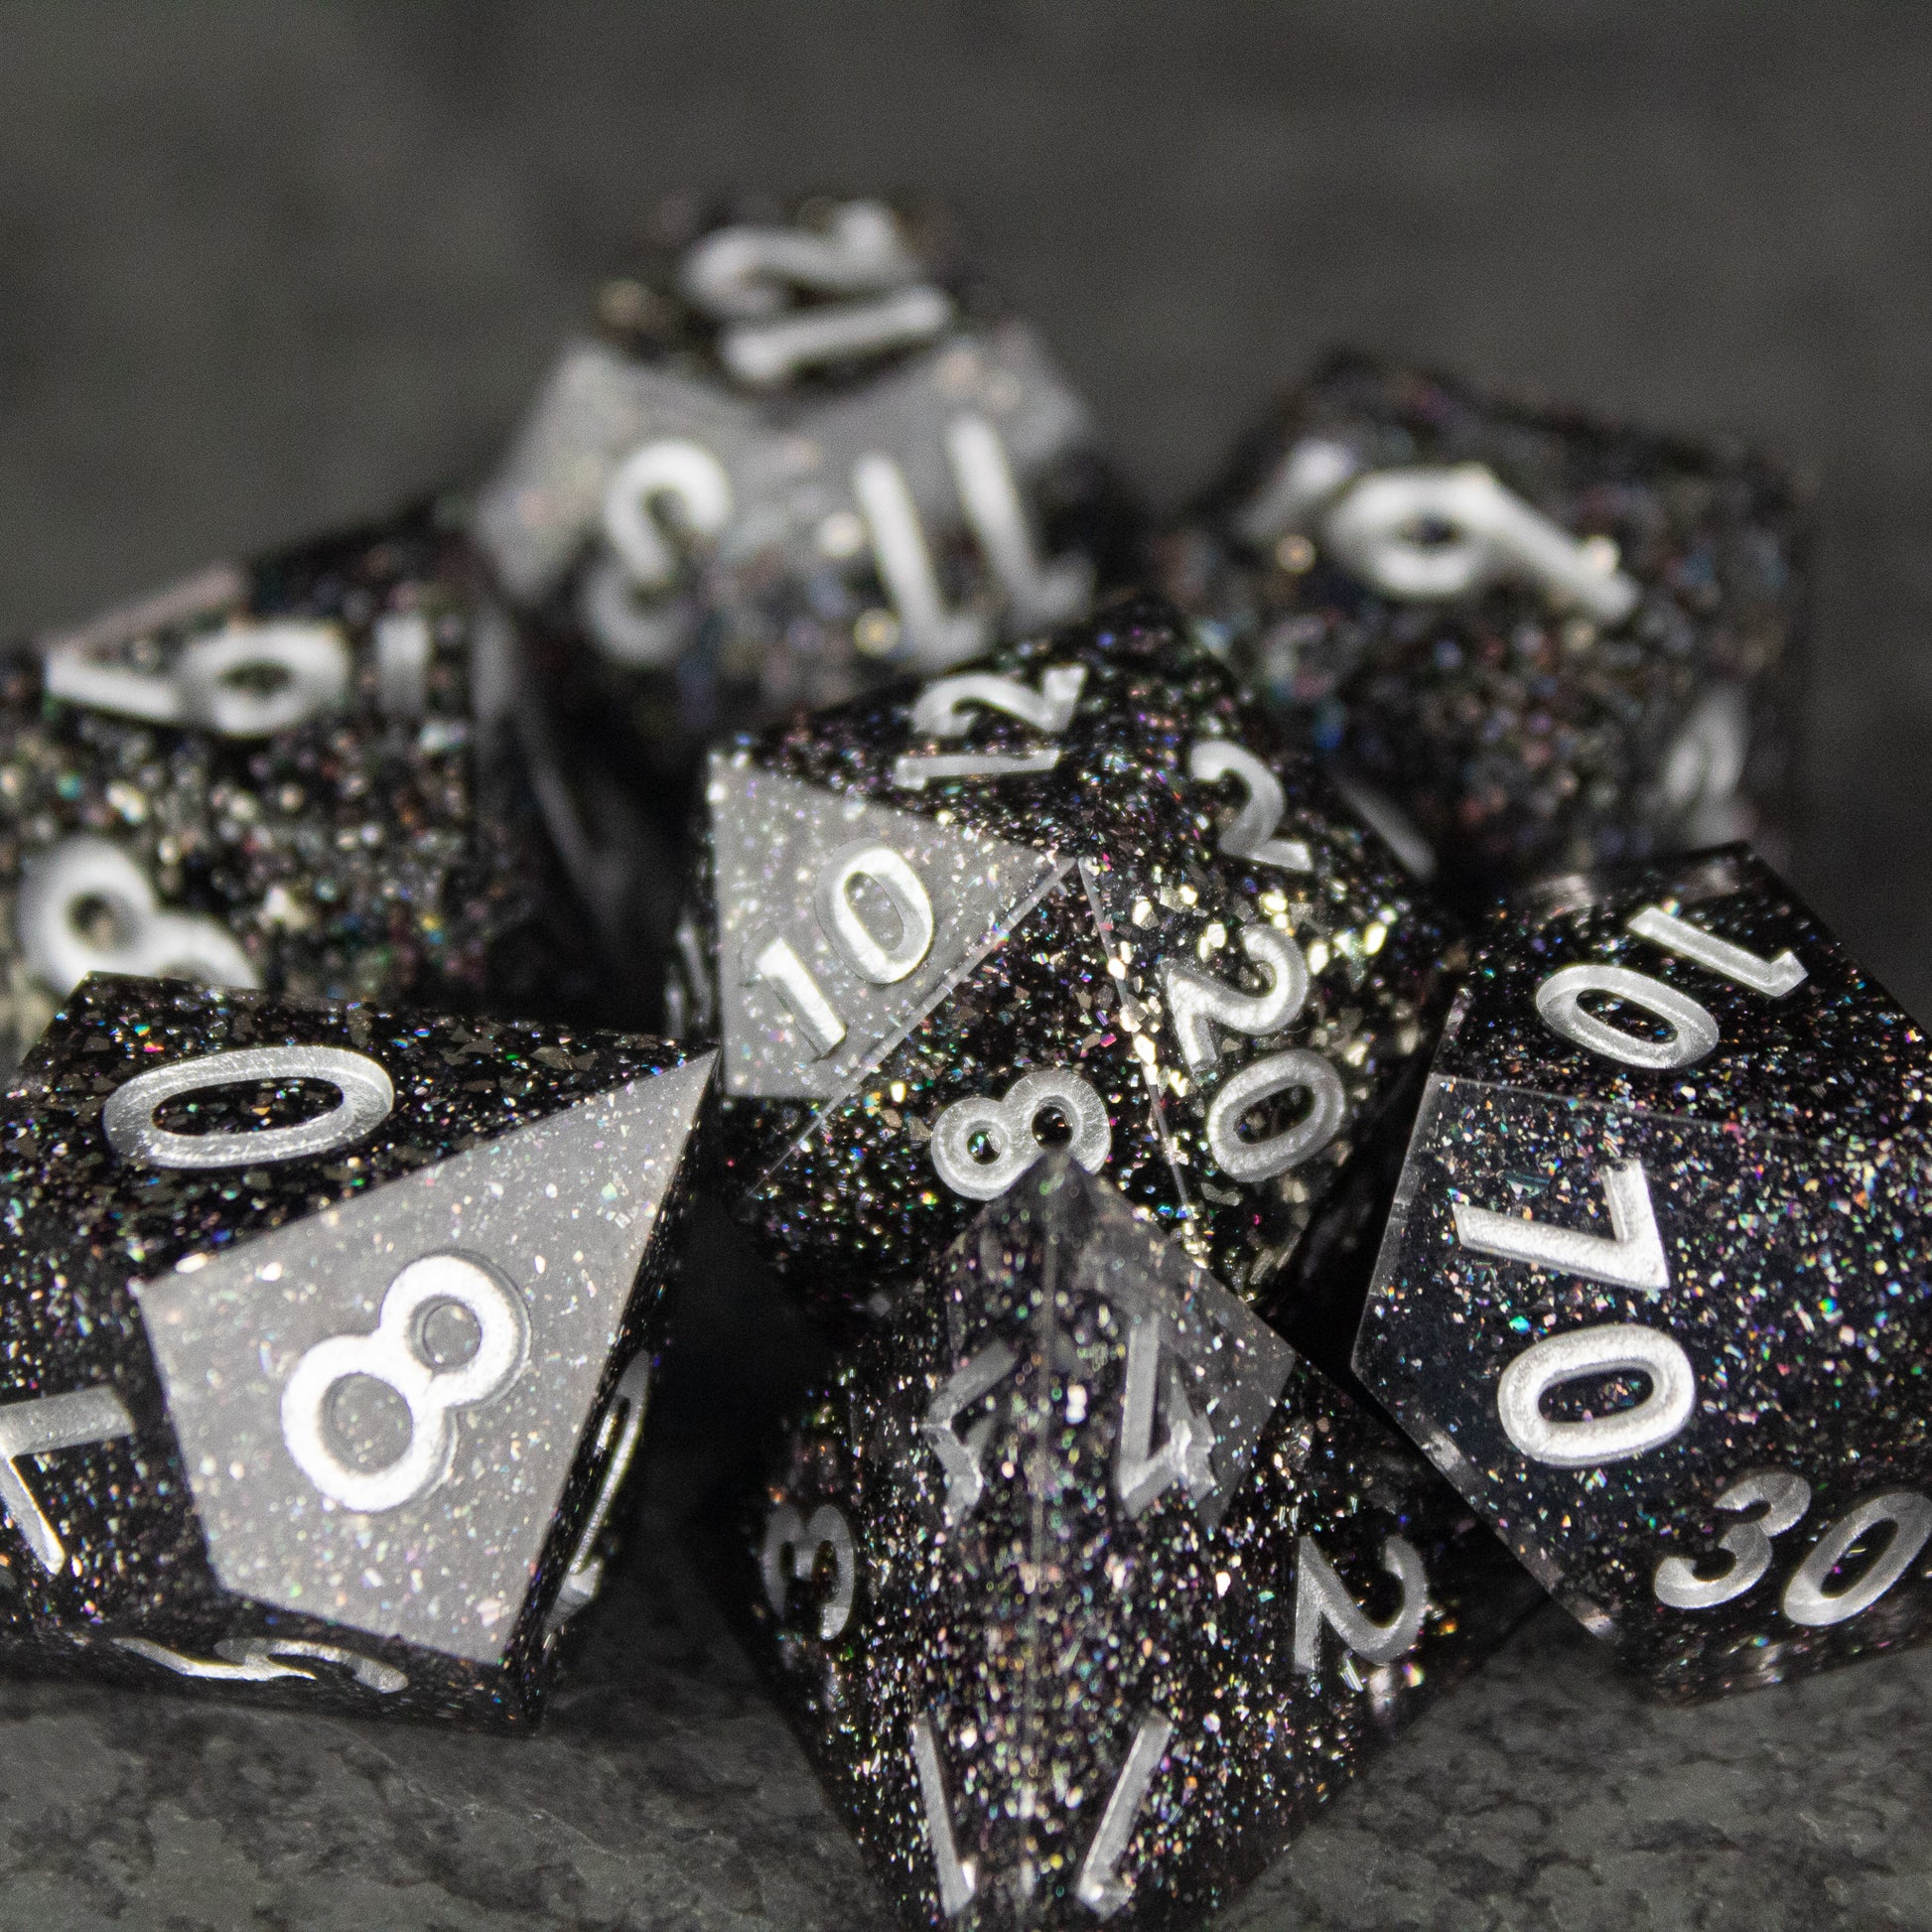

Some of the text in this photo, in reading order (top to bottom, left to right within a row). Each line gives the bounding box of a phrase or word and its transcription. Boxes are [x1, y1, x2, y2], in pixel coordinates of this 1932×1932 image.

[894, 666, 1089, 792] 12
[1189, 740, 1312, 874] 2
[743, 839, 935, 1060] 10
[1535, 904, 1809, 1071] 10
[102, 1044, 395, 1170] 0
[1160, 923, 1346, 1182] 20
[930, 1068, 1112, 1199] 8
[280, 1251, 530, 1513] 8
[1452, 1158, 1697, 1467] 70
[759, 1503, 856, 1641] 3
[1294, 1535, 1430, 1674] 2
[1654, 1472, 1932, 1628] 30
